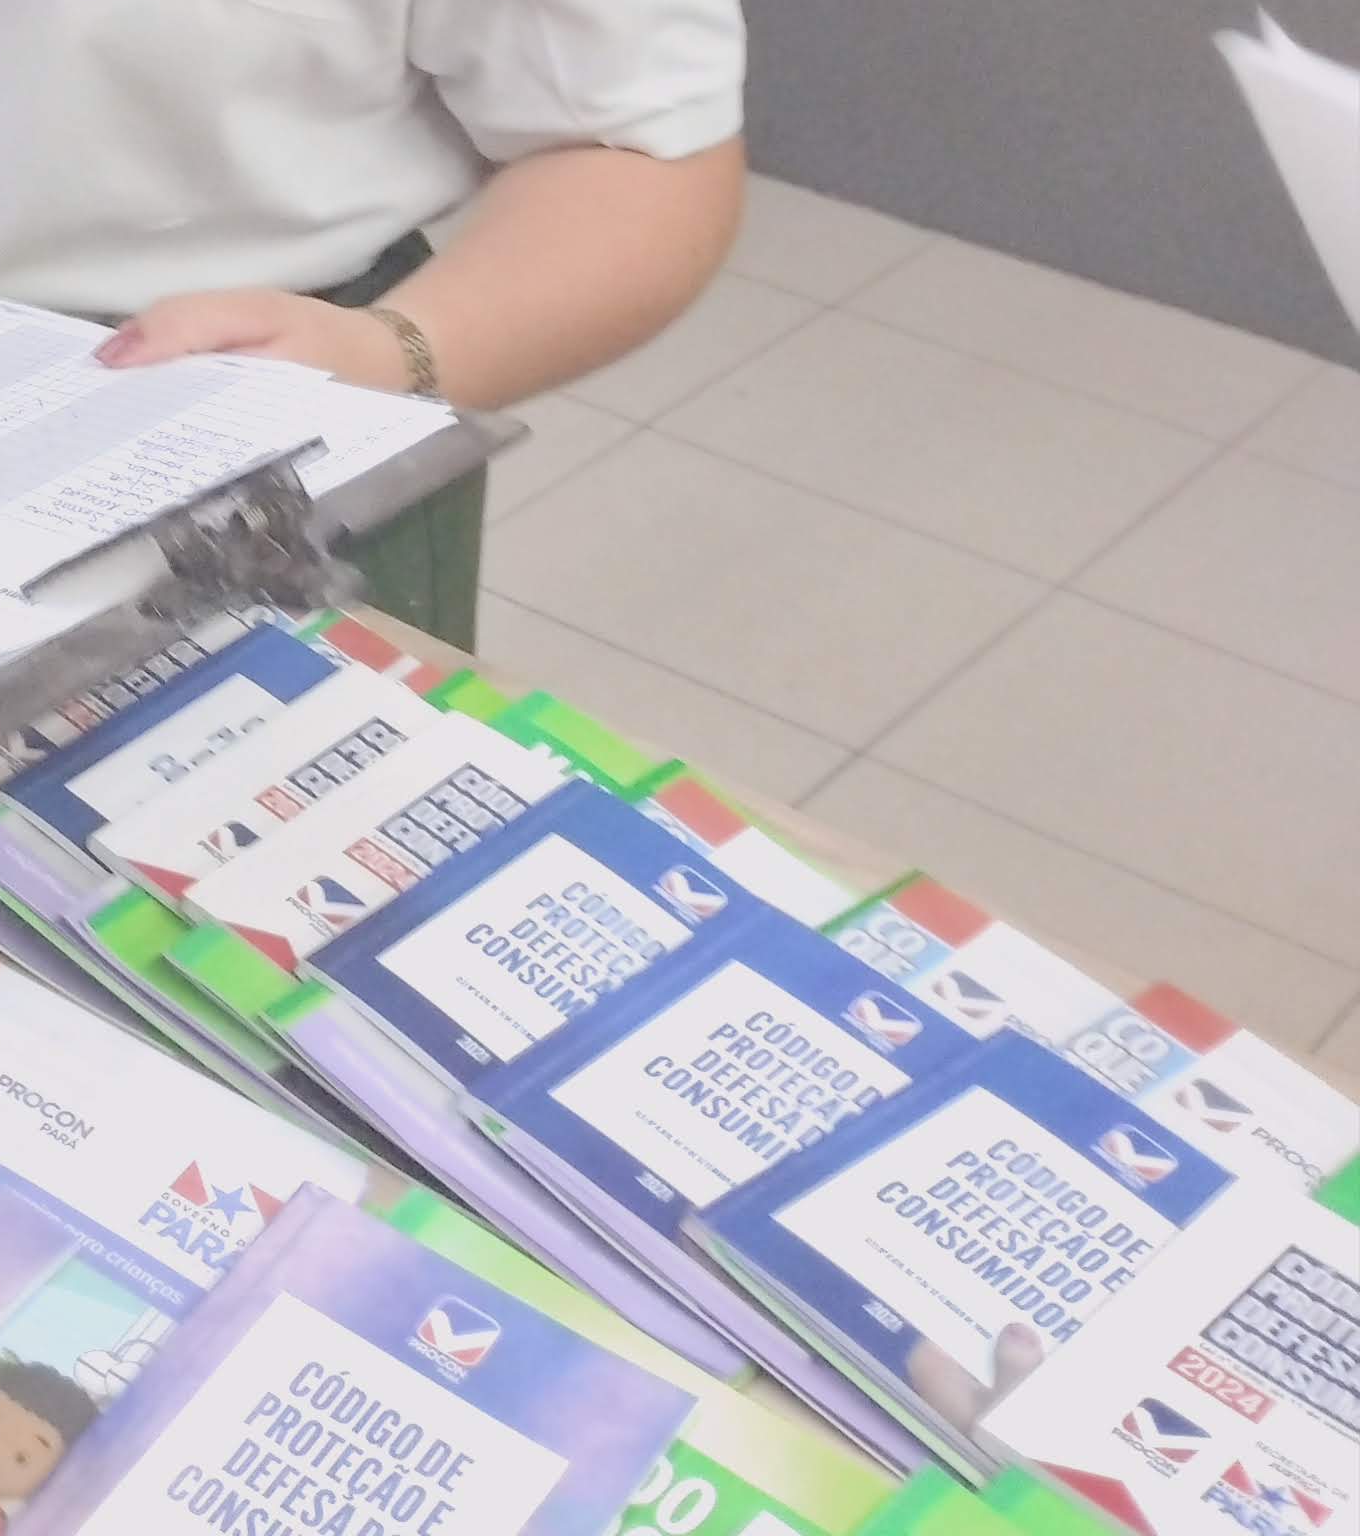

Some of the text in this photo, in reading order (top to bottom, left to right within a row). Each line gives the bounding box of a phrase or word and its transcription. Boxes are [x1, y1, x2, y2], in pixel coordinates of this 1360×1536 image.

[643, 1055, 787, 1162] CONSUMI
[690, 1049, 802, 1135] DEFESA
[796, 1124, 825, 1150] D
[744, 1011, 859, 1093] CÓDIGO
[852, 1085, 882, 1111] D
[39, 1121, 80, 1150] PARÁ
[1250, 1126, 1324, 1183] PROC
[161, 1191, 231, 1239] GOVERNO
[926, 1175, 1047, 1271] DEFESA
[1036, 1260, 1094, 1304] DO
[946, 1150, 1110, 1274] PROTEÇÃO
[1099, 1265, 1136, 1295] E
[986, 1138, 1109, 1230] CÓDIGO
[1098, 1222, 1155, 1265] DE
[105, 1249, 185, 1306] crianças
[876, 1181, 1085, 1345] CONSUMIDOR
[406, 1335, 469, 1380] PROCON
[1175, 1351, 1266, 1415] 2024
[243, 1390, 456, 1536] PROTEÇÃO E
[287, 1360, 475, 1494] CÓDIGO DE
[1111, 1426, 1181, 1476] PROCON
[222, 1437, 357, 1536] DEFESA
